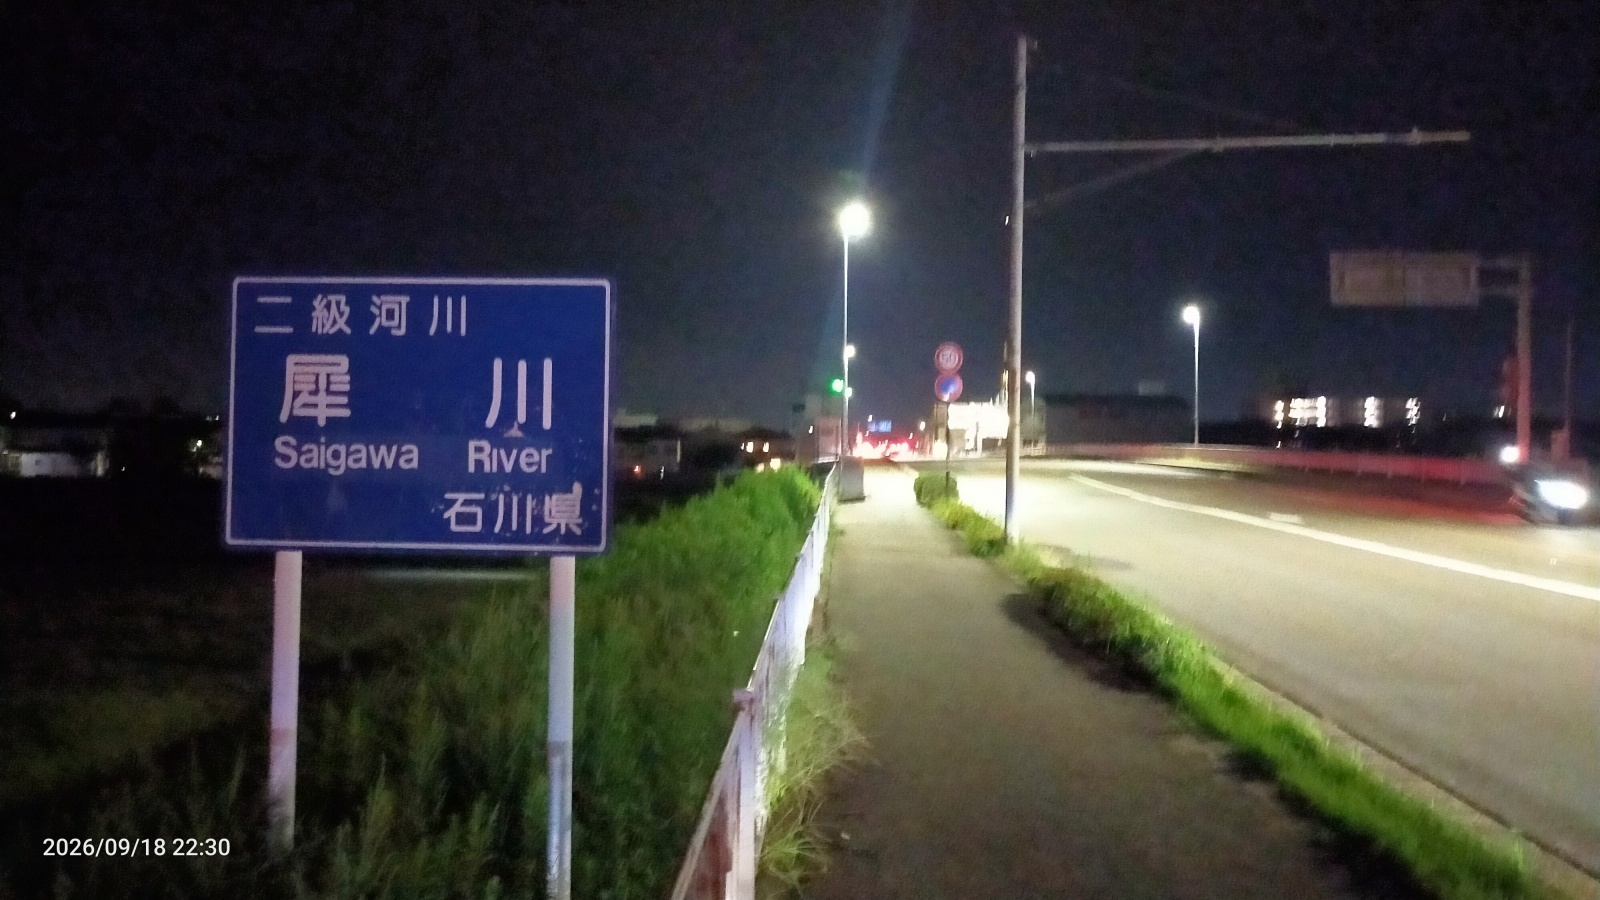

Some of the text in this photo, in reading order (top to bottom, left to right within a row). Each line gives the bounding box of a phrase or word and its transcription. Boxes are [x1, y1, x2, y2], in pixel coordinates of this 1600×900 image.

[254, 294, 467, 336] 二級河川
[274, 435, 553, 476] Saigawa River
[443, 490, 583, 536] 石川県
